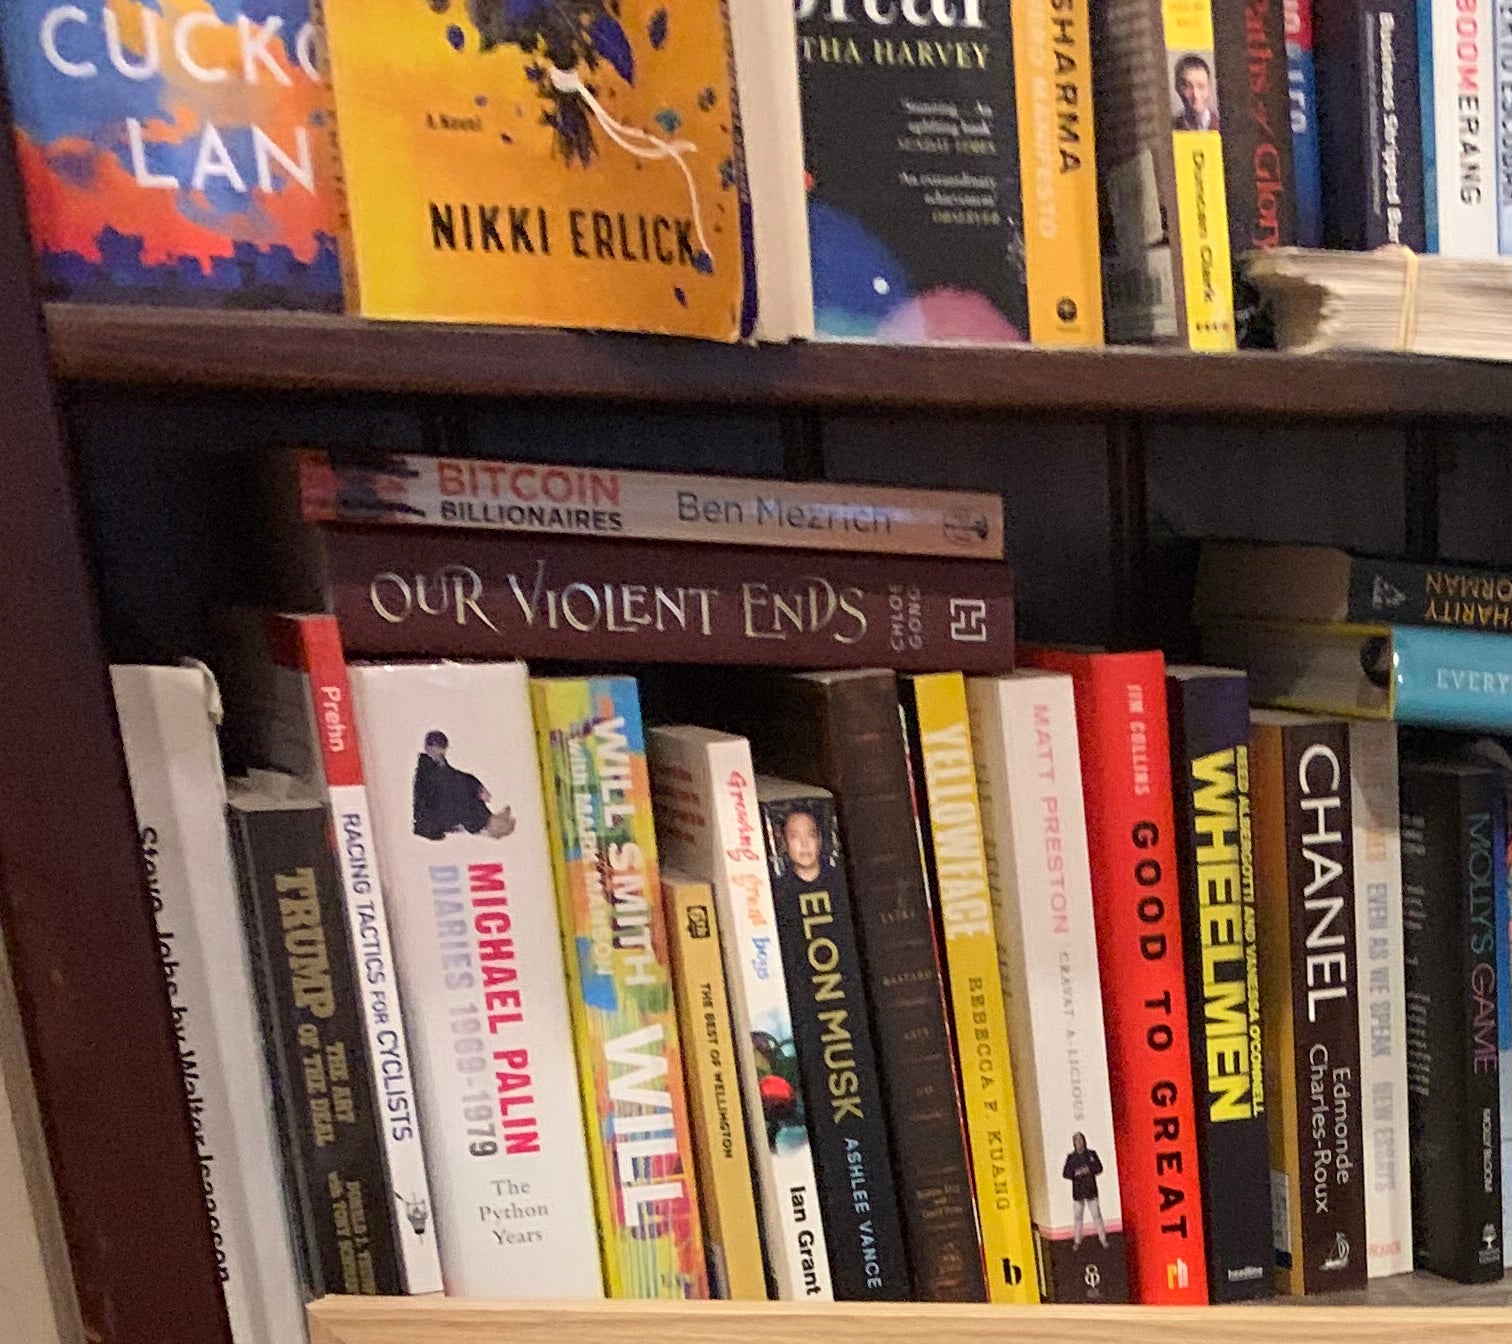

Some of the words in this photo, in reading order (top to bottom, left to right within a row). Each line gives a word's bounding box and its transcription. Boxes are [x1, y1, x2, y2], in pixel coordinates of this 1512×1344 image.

[872, 37, 989, 69] HARVEY
[1456, 0, 1482, 207] BOOMERANG
[126, 117, 315, 196] LAN
[1191, 149, 1209, 244] Duncan
[1251, 143, 1284, 251] Glory
[428, 201, 551, 256] NIKKI
[569, 208, 699, 268] ERLICK
[1199, 244, 1213, 303] Clark
[435, 459, 623, 504] BITCOIN
[440, 501, 624, 533] BILLIONAIRES
[677, 490, 746, 524] Ben
[752, 495, 894, 534] Mezrich
[369, 564, 500, 633] OUR
[505, 558, 721, 637] VIOLENT
[742, 576, 869, 644] ENDS
[319, 685, 345, 753] Prehn
[1032, 703, 1057, 784] MATT
[1129, 721, 1151, 796] COLLINS
[592, 715, 637, 828] WILL
[341, 812, 372, 896] RACING
[726, 770, 761, 863] Growing
[751, 935, 771, 983] boys
[1040, 796, 1071, 934] PRESTON
[1131, 820, 1168, 961] GOOD
[1299, 742, 1348, 1023] CHANEL
[275, 866, 337, 1019] TRUMP
[354, 898, 387, 991] TACTICS
[428, 864, 476, 993] DIARIES
[467, 862, 524, 1035] MICHAEL
[608, 842, 657, 987] SMITH
[798, 889, 847, 1003] ELON
[1191, 746, 1253, 1123] WHEELMEN
[1366, 882, 1388, 931] EVEN
[1368, 935, 1390, 961] AS
[369, 990, 391, 1025] FOR
[700, 981, 713, 1008] THE
[1144, 990, 1175, 1052] TO
[1369, 965, 1391, 994] WE
[1470, 961, 1498, 1076] GAME
[704, 1010, 719, 1047] BEST
[816, 1009, 866, 1125] MUSK
[1369, 1000, 1393, 1059] SPEAK
[376, 1029, 415, 1143] CYCLISTS
[493, 1048, 541, 1156] PALIN
[602, 1021, 685, 1229] WILL
[713, 1070, 734, 1160] WELLINGTON
[967, 976, 997, 1091] REBECCA
[987, 1129, 1011, 1211] KUANG
[1309, 1042, 1333, 1215] Charles-Roux
[1332, 1066, 1355, 1186] Edmonde
[491, 1179, 531, 1196] The
[843, 1136, 872, 1215] ASHLEE
[1151, 1079, 1189, 1240] GREAT
[478, 1203, 550, 1223] Python
[491, 1230, 544, 1246] Years
[788, 1184, 807, 1224] Ian
[796, 1230, 822, 1297] Grant
[857, 1219, 884, 1290] VANCE
